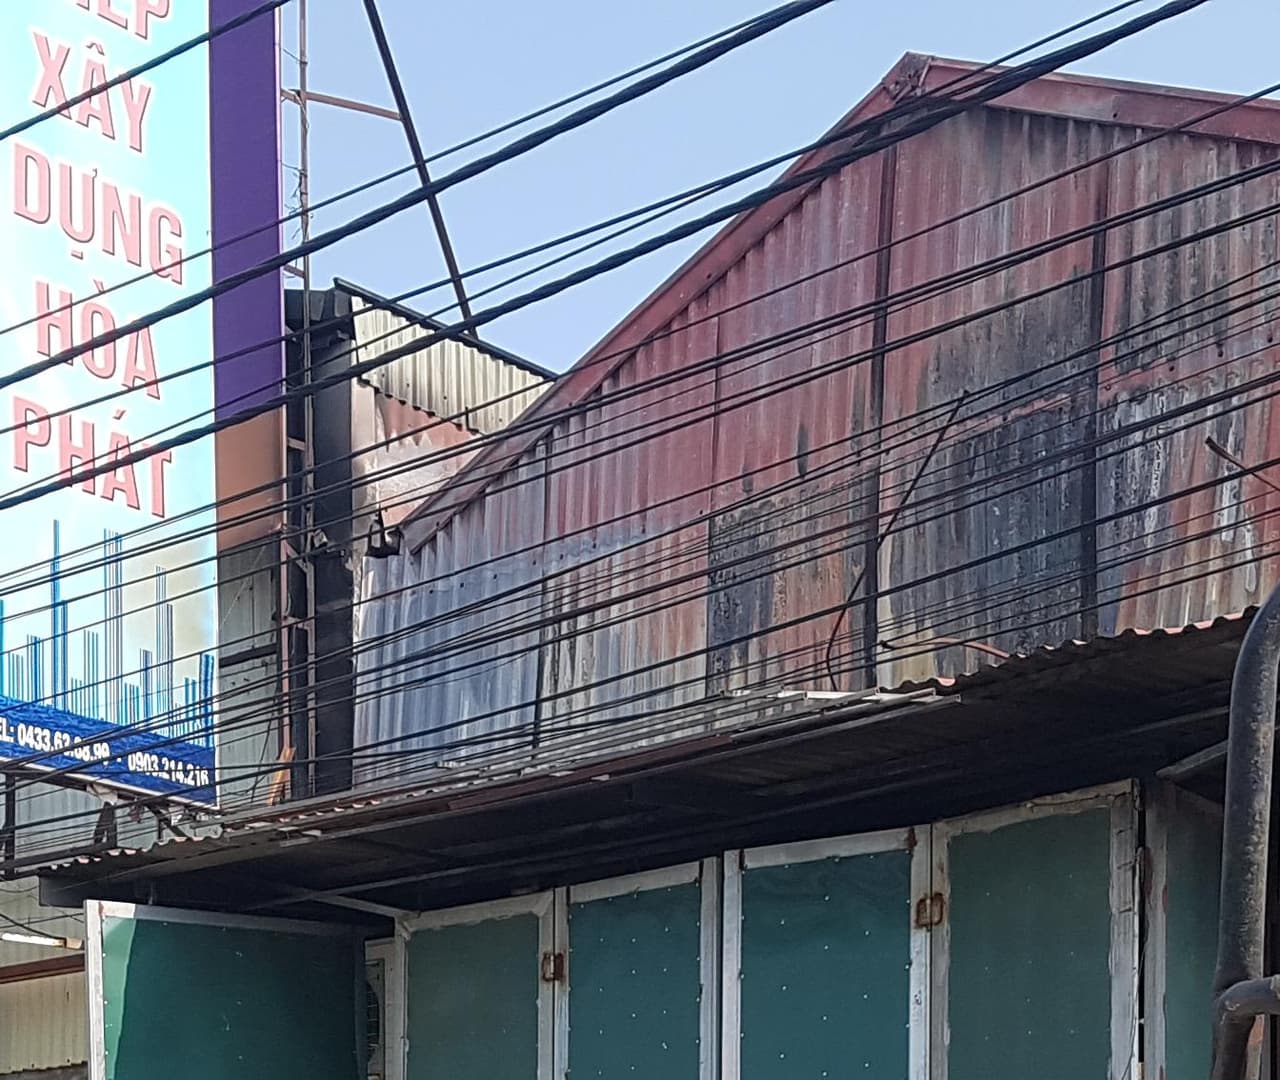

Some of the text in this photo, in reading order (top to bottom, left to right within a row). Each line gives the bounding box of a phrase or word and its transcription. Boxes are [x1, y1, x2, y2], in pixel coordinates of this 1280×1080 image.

[31, 31, 152, 154] XÂY
[13, 142, 183, 286] DỰNG
[35, 279, 161, 401] HÒA
[13, 395, 172, 519] PHÁT
